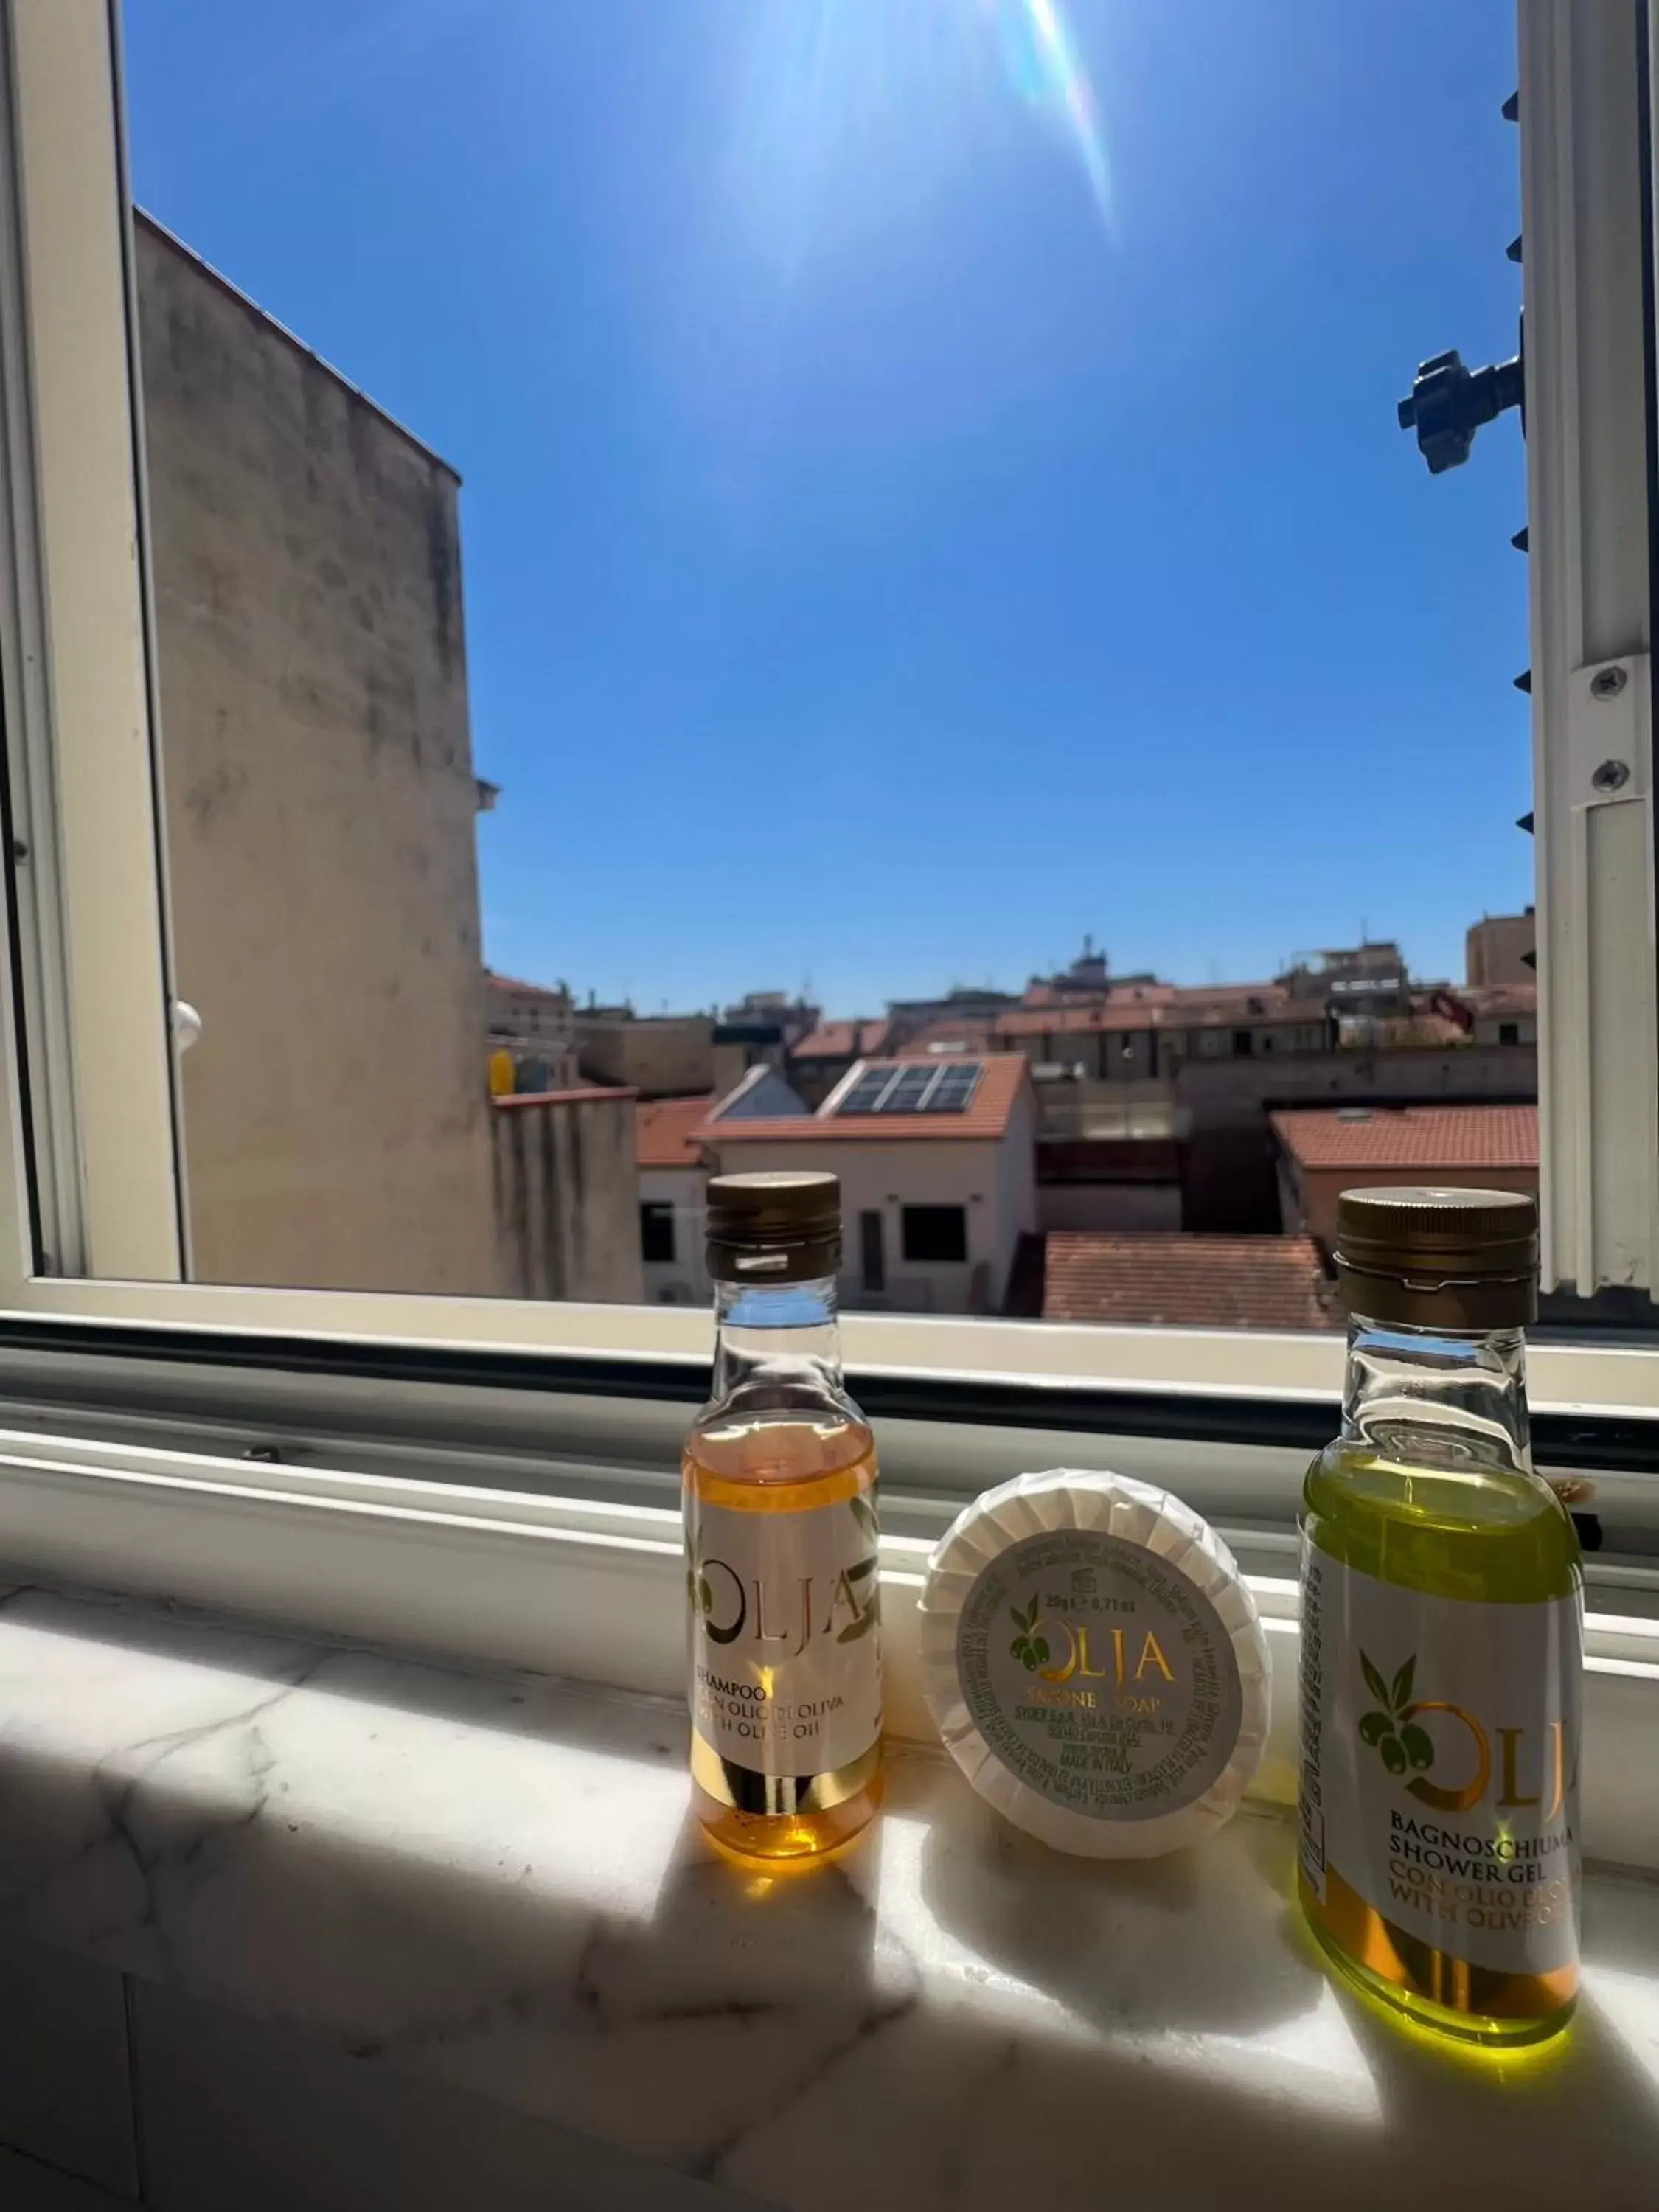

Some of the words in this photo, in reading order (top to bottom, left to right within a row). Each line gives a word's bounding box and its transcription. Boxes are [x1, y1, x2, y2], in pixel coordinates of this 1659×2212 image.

[1031, 1619, 1178, 1686] OLJA
[798, 1696, 845, 1719] OLIVA
[1389, 1834, 1504, 1882] SHOWER
[1508, 1863, 1547, 1883] GEL
[1389, 1858, 1444, 1897] CON
[1455, 1885, 1516, 1908] OLIO
